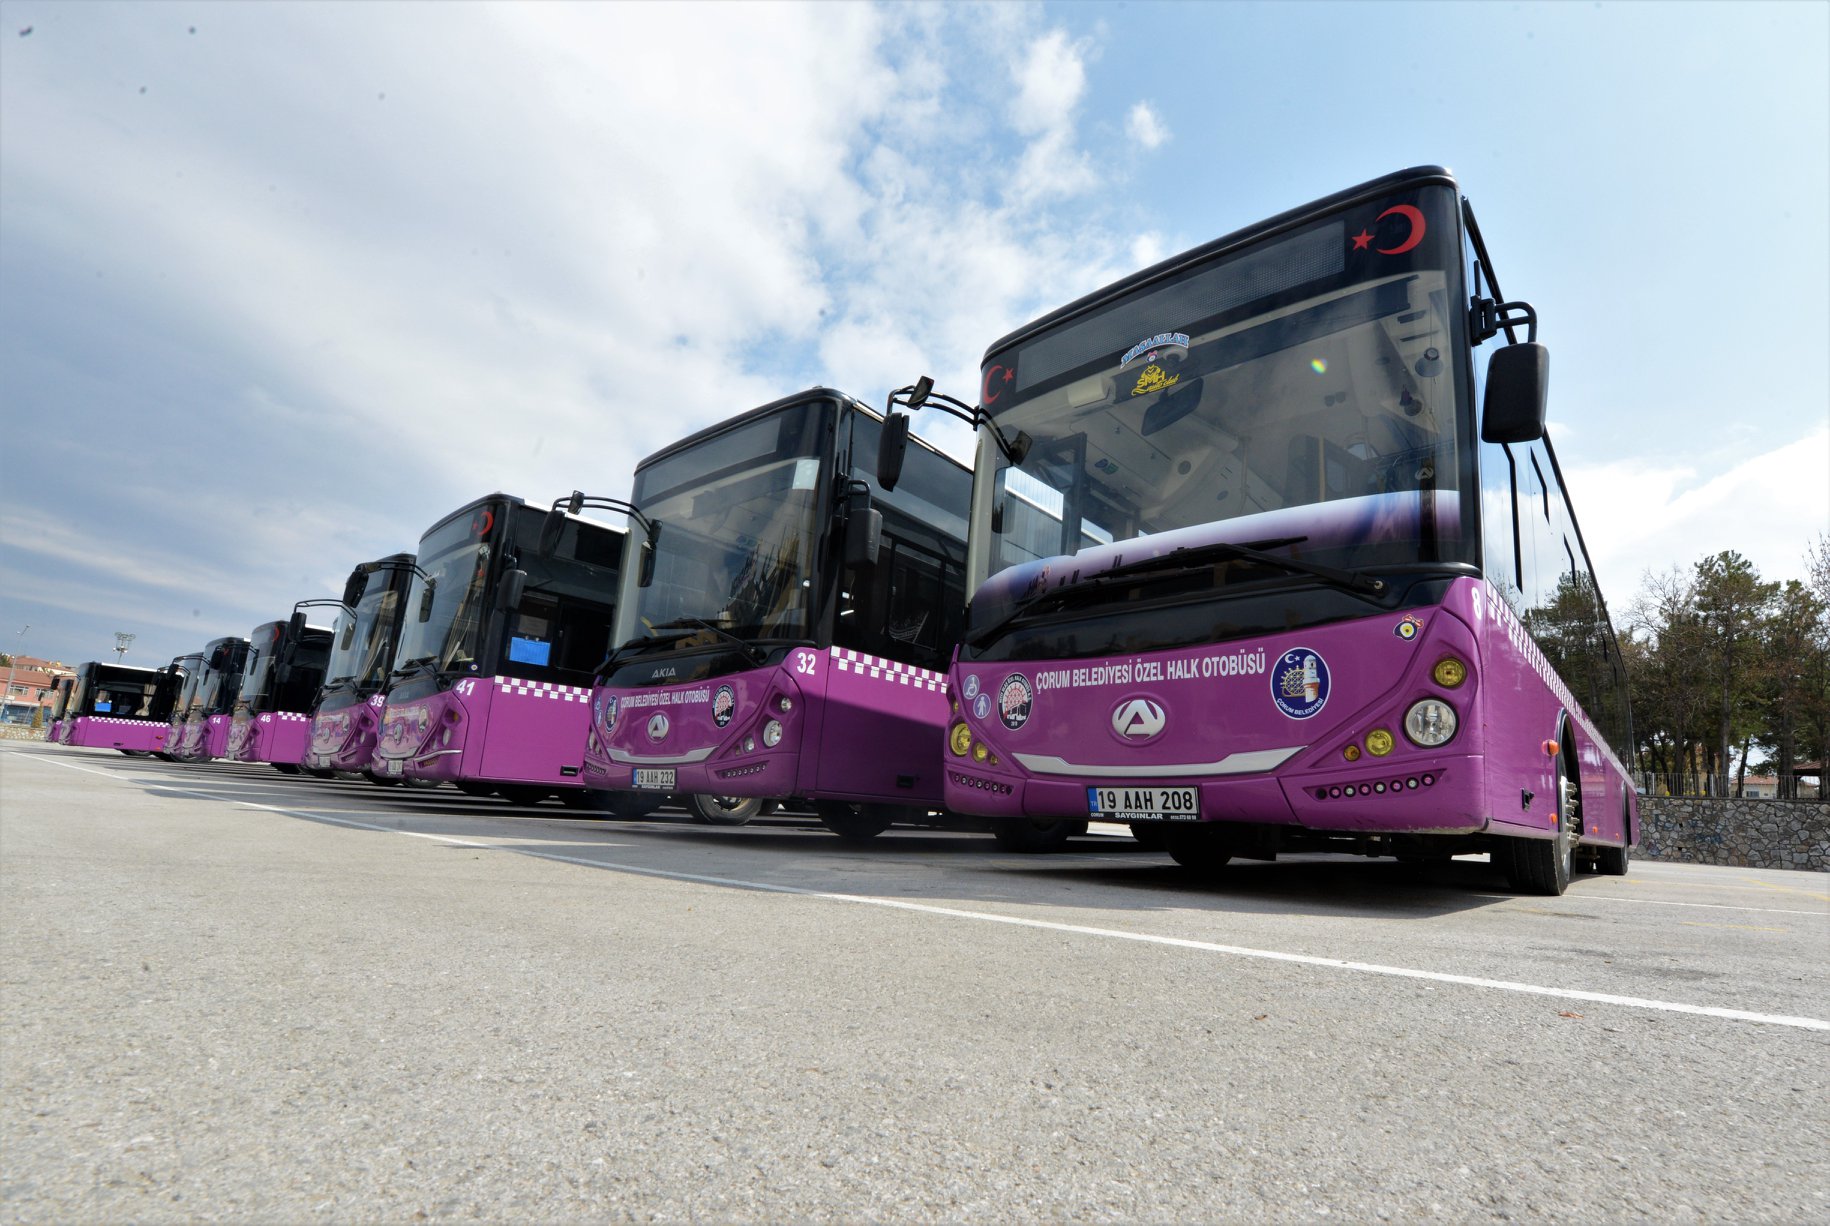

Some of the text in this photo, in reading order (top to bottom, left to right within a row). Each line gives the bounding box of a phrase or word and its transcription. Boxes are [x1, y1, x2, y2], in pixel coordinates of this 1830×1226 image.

[1136, 369, 1166, 389] SMH
[1471, 586, 1482, 620] 8
[651, 667, 676, 678] AKIA
[796, 652, 816, 676] 32
[1035, 669, 1070, 695] ÇORUM
[1072, 659, 1133, 687] BELEDİYESİ
[1134, 658, 1164, 683] ÖZEL
[1167, 658, 1200, 680] HALK
[1202, 647, 1266, 678] OTOBÜSÜ
[455, 679, 475, 696] 41
[671, 689, 685, 704] HALK
[684, 685, 710, 704] OTOBÜSÜ
[370, 694, 385, 707] 39
[212, 717, 222, 725] 14
[260, 714, 271, 723] 46
[637, 770, 645, 784] 19
[660, 770, 674, 785] 232
[1098, 790, 1117, 809] 19
[1124, 790, 1154, 810] AAH
[1160, 790, 1194, 810] 208
[1114, 812, 1164, 820] SAYGINLAR
